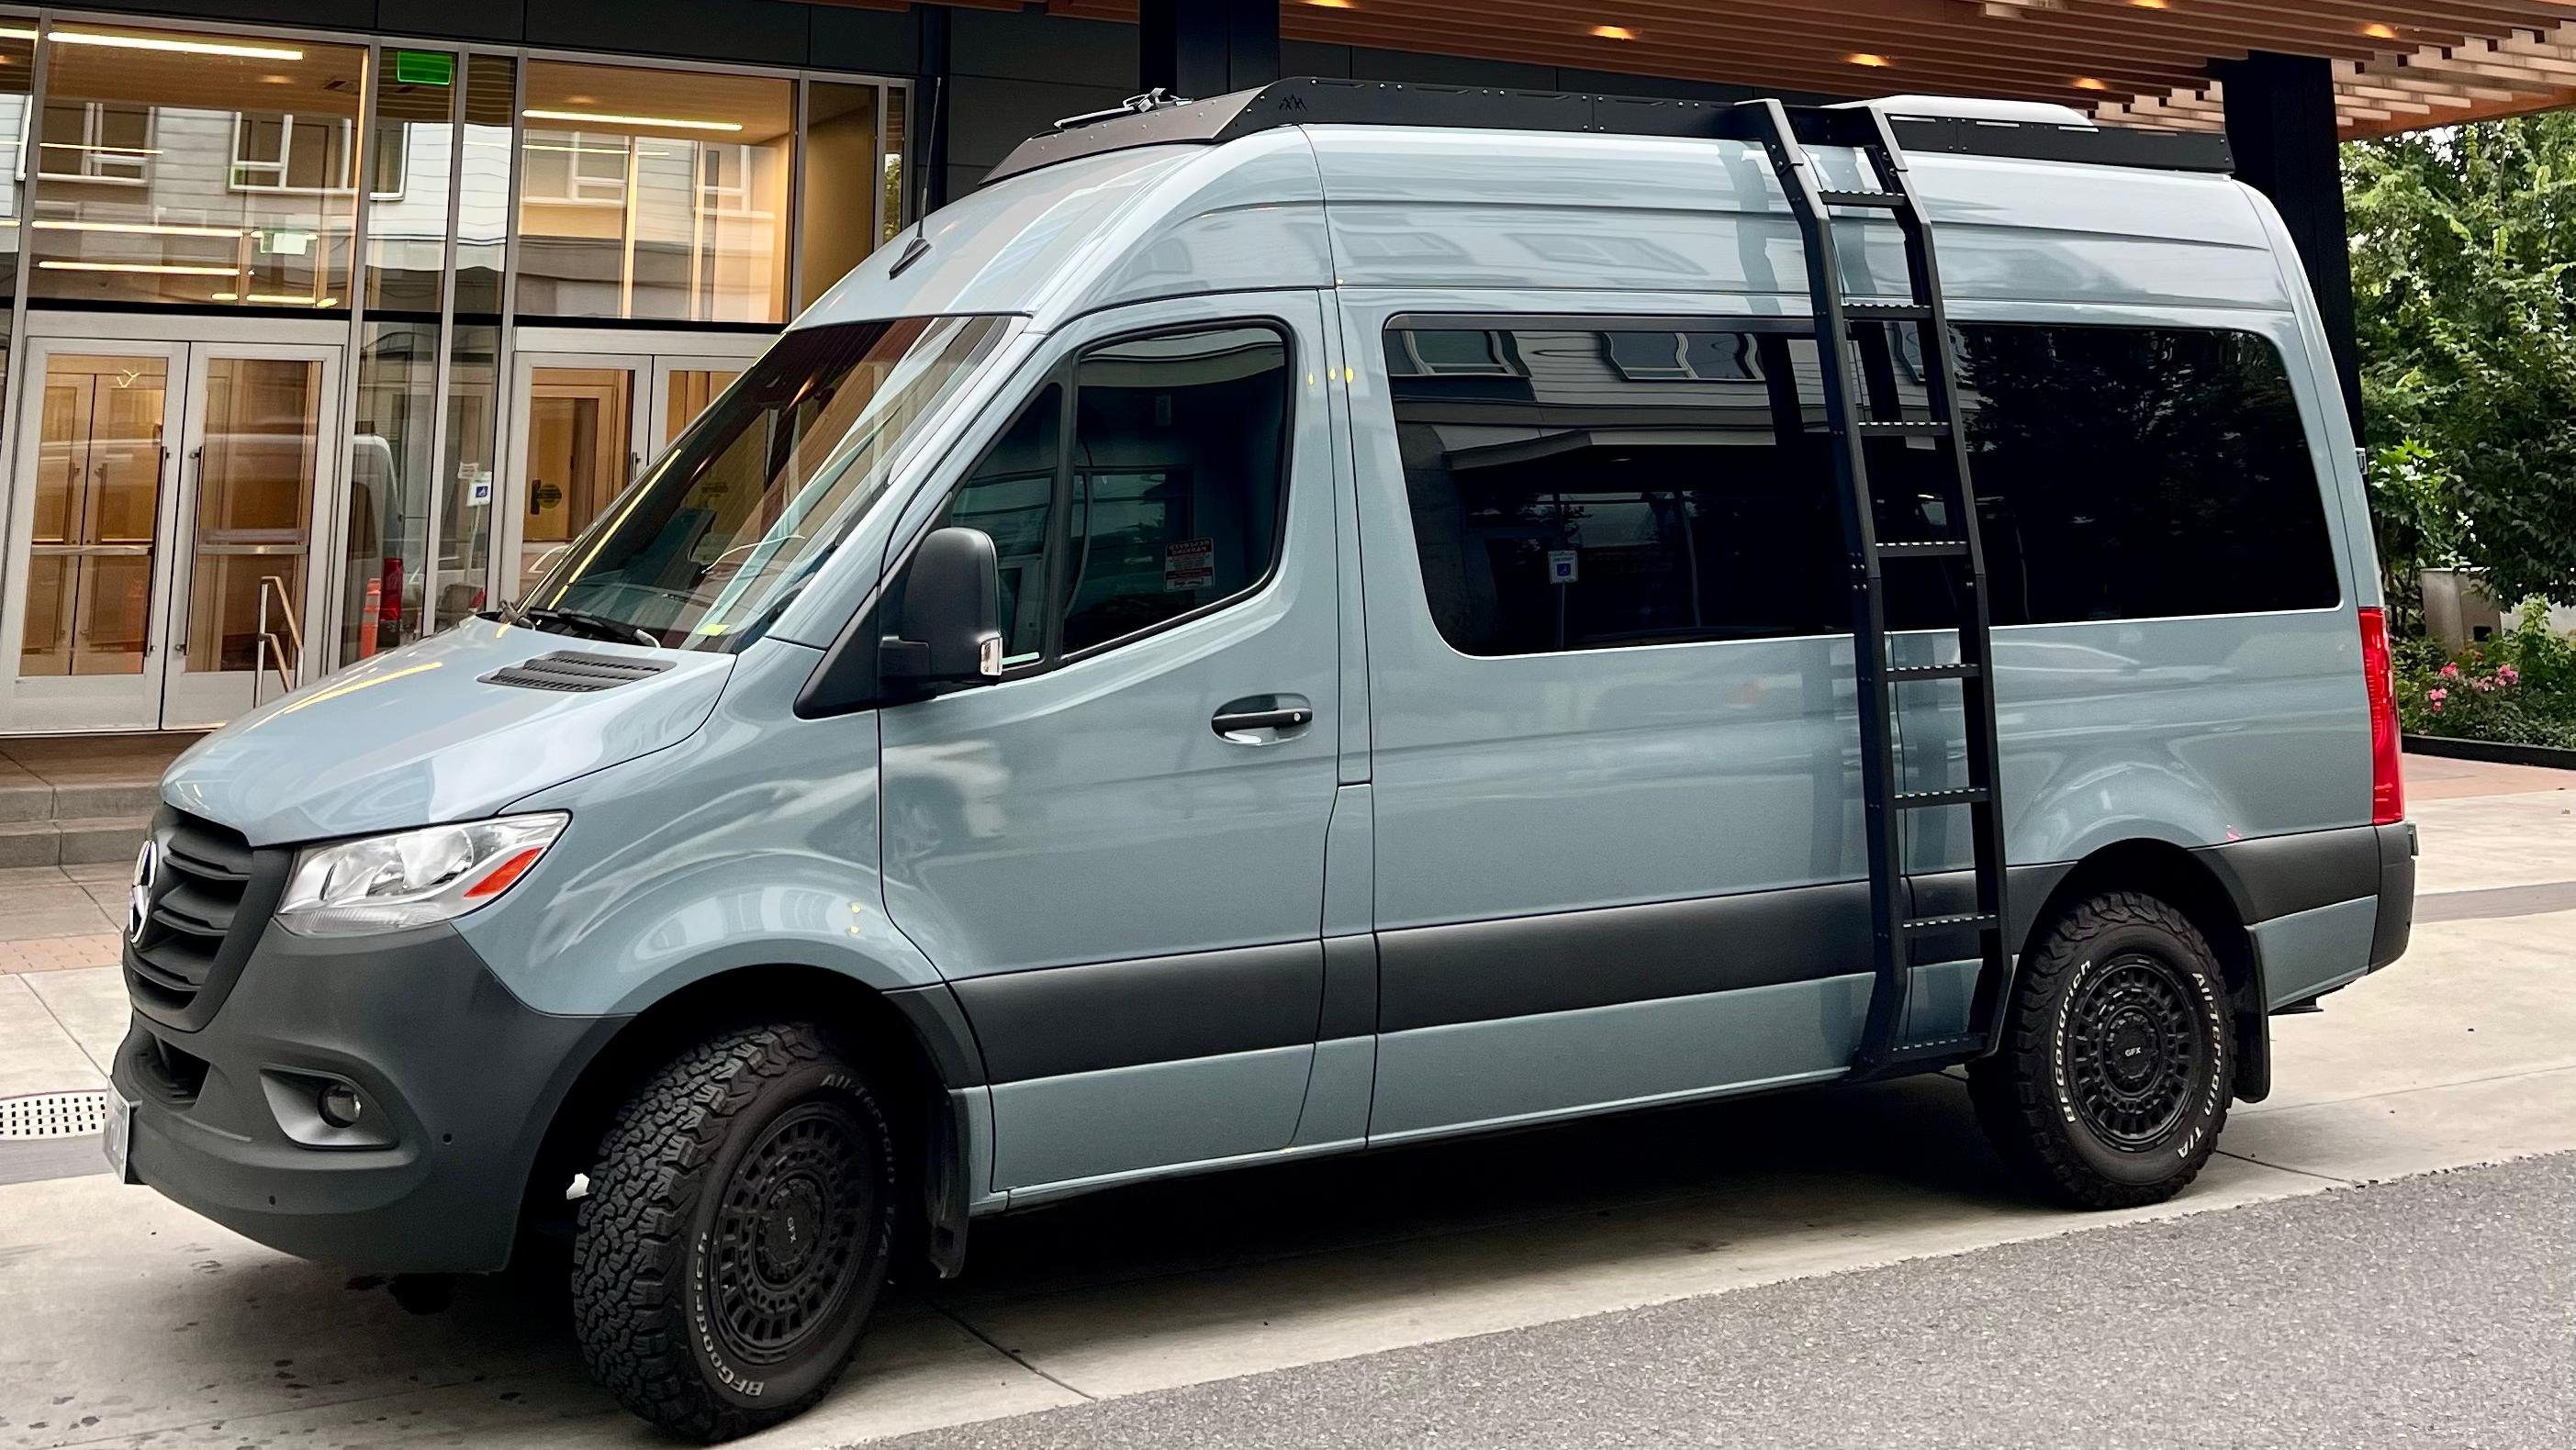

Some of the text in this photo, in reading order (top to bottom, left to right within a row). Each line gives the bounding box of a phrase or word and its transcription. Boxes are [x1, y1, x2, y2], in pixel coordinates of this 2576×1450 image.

[2055, 960, 2091, 1122] BFGoodrich
[2124, 1046, 2141, 1056] GFX
[695, 1232, 764, 1397] BFGoodrich
